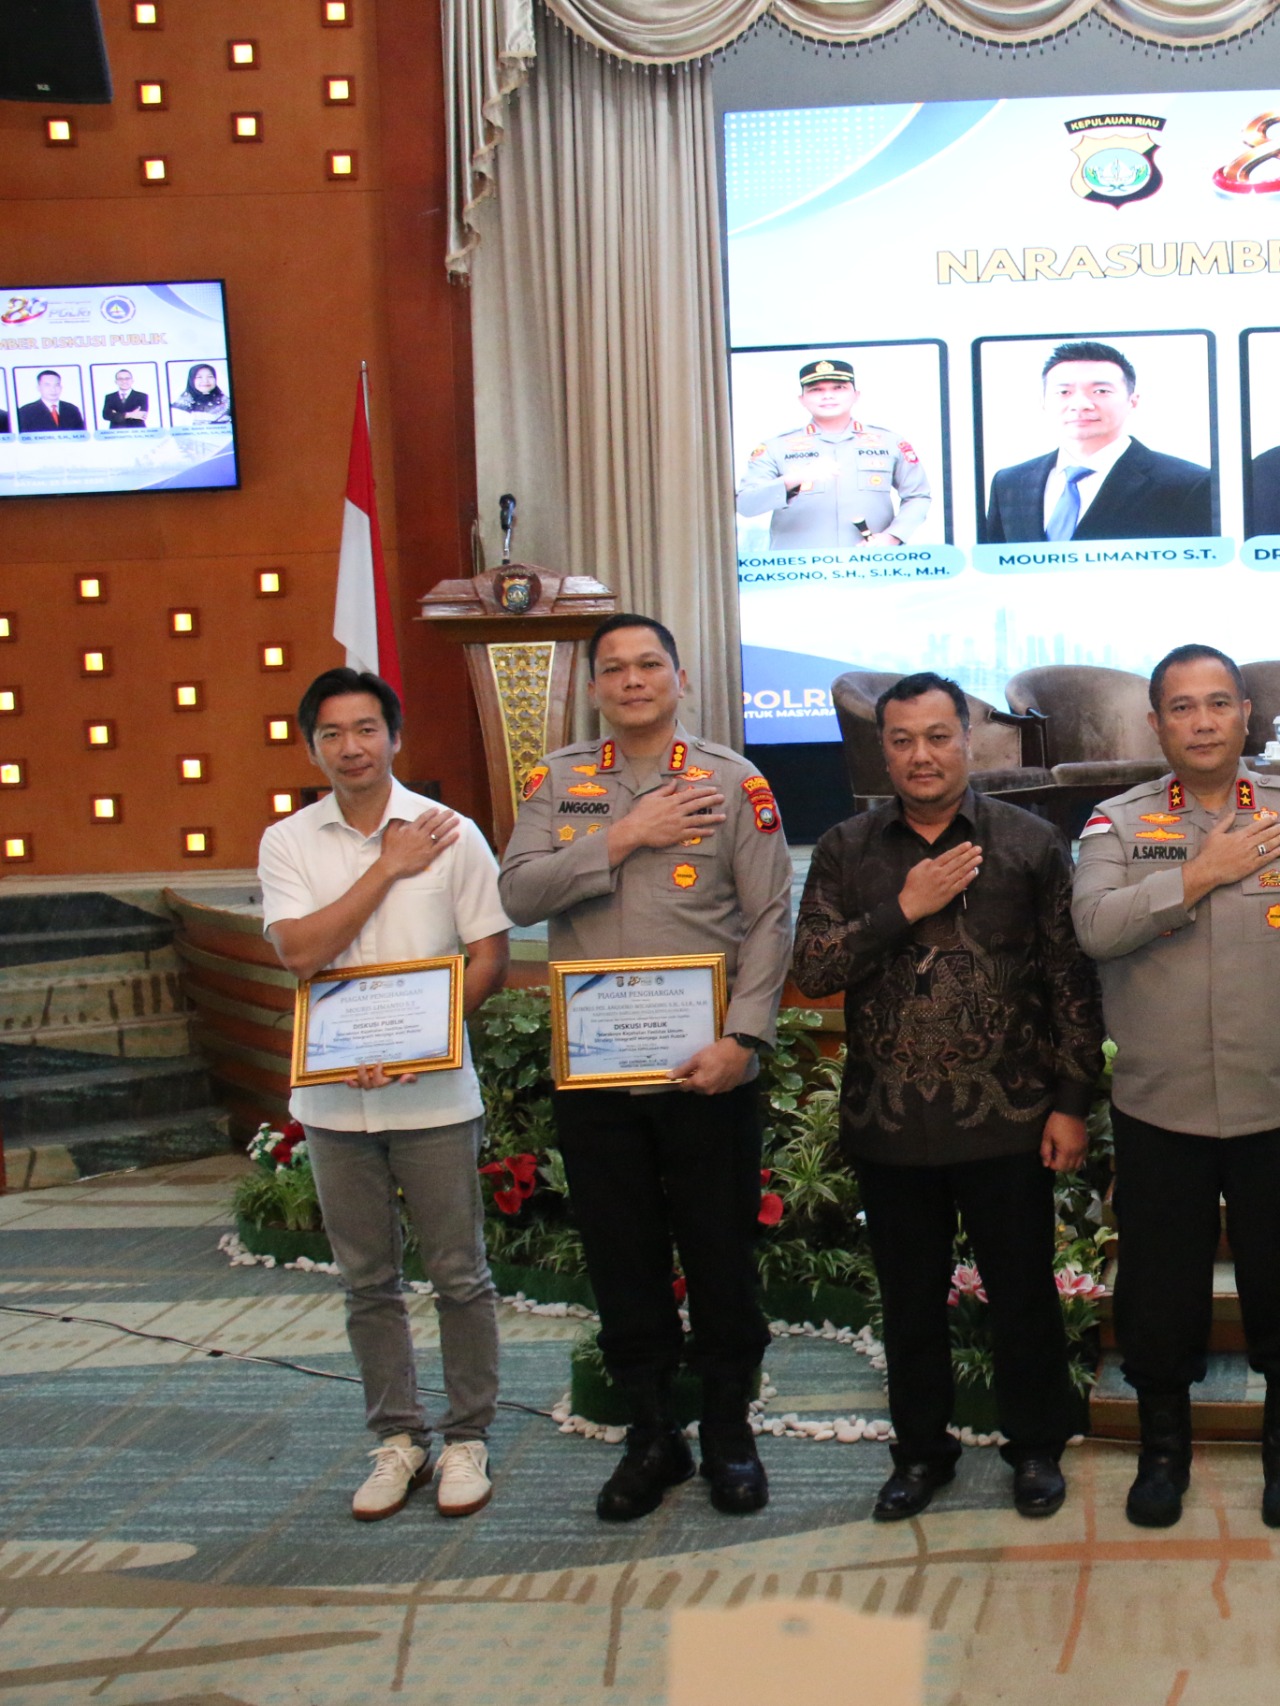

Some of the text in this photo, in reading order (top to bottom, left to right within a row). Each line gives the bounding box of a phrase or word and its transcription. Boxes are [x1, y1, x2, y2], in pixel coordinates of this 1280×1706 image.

[1070, 116, 1160, 131] KEPULAUAN RIAU
[41, 335, 107, 349] DISKUSI
[109, 332, 168, 347] PUBLIK
[739, 551, 932, 567] KOMBES POL ANGGORO
[999, 548, 1217, 566] MOURIS LIMANTO S.T.
[739, 566, 950, 583] ICAKSONO, S.H., S.I.K., M.H.
[744, 708, 837, 719] TUK MASYARA
[558, 801, 610, 814] ANGGORO
[1132, 845, 1187, 860] A.SAFRUDIN
